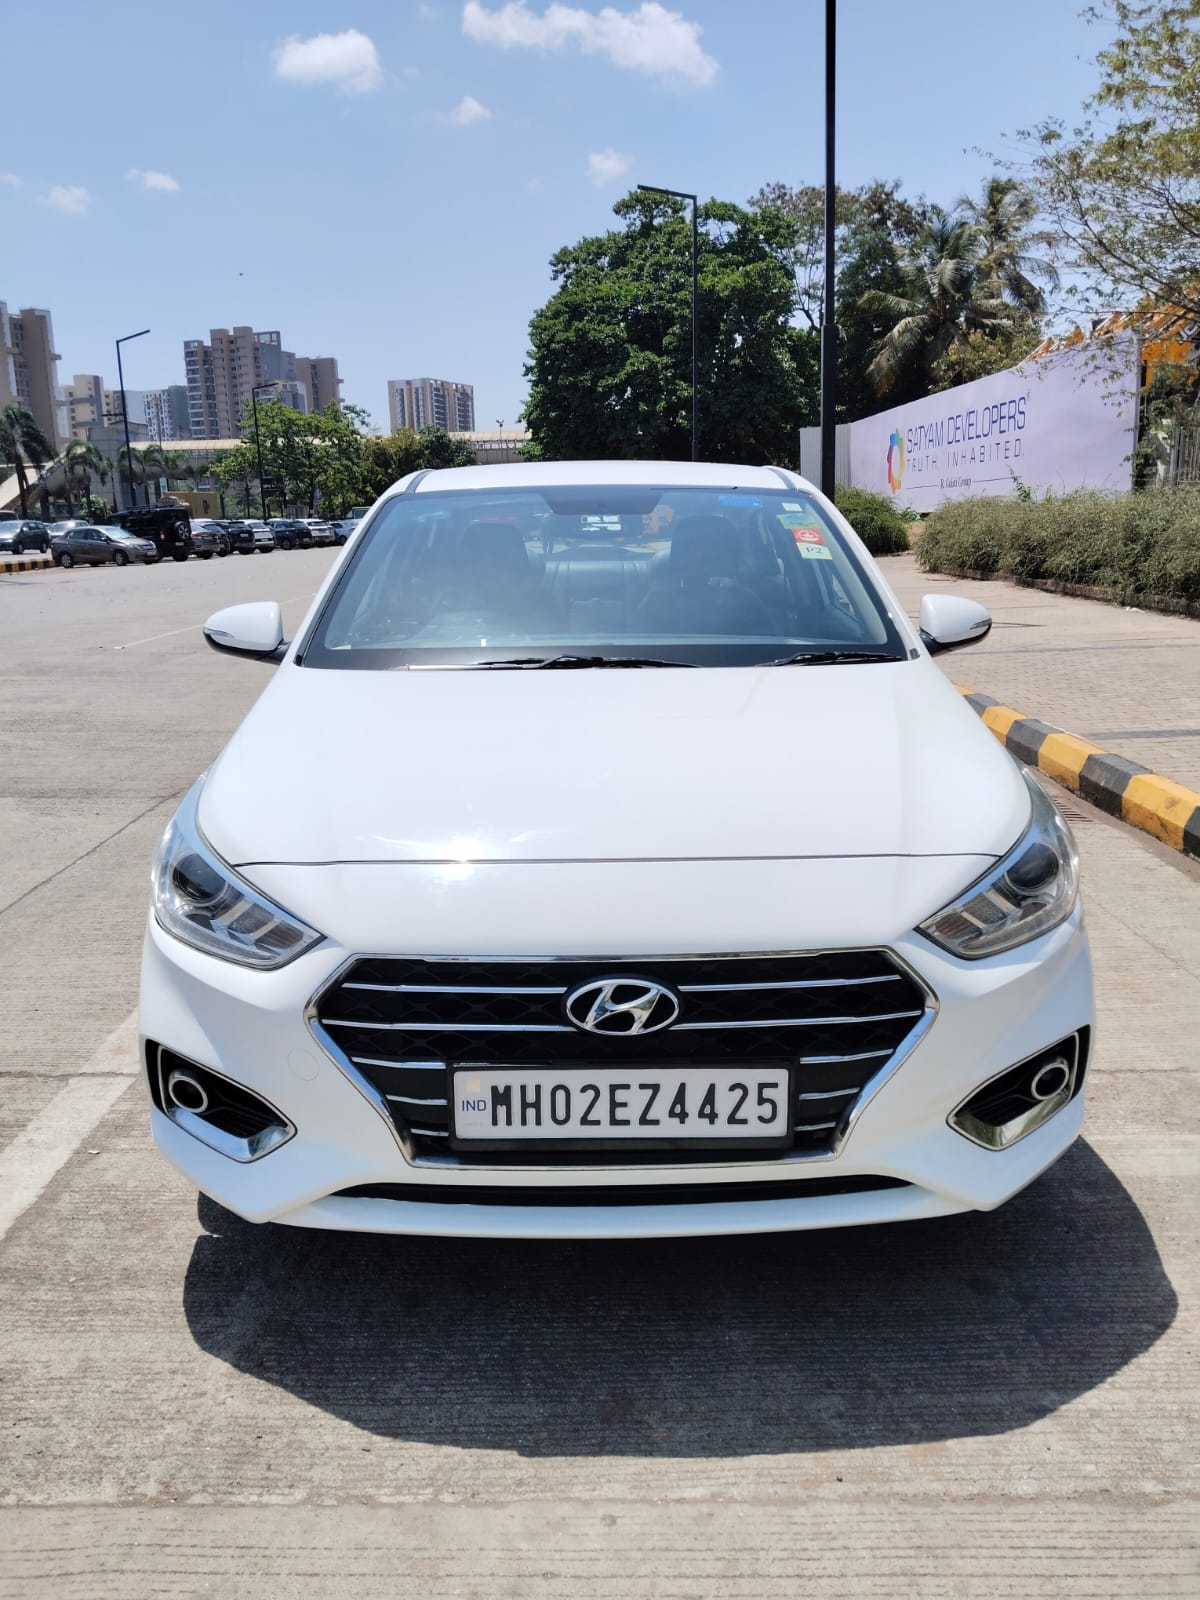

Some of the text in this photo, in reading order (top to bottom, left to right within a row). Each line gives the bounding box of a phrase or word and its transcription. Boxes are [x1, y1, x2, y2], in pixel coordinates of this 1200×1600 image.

[907, 396, 1026, 454] SATYAM DEVELOPERS
[462, 1099, 487, 1111] IND
[490, 1082, 779, 1127] MH02EZ4425
